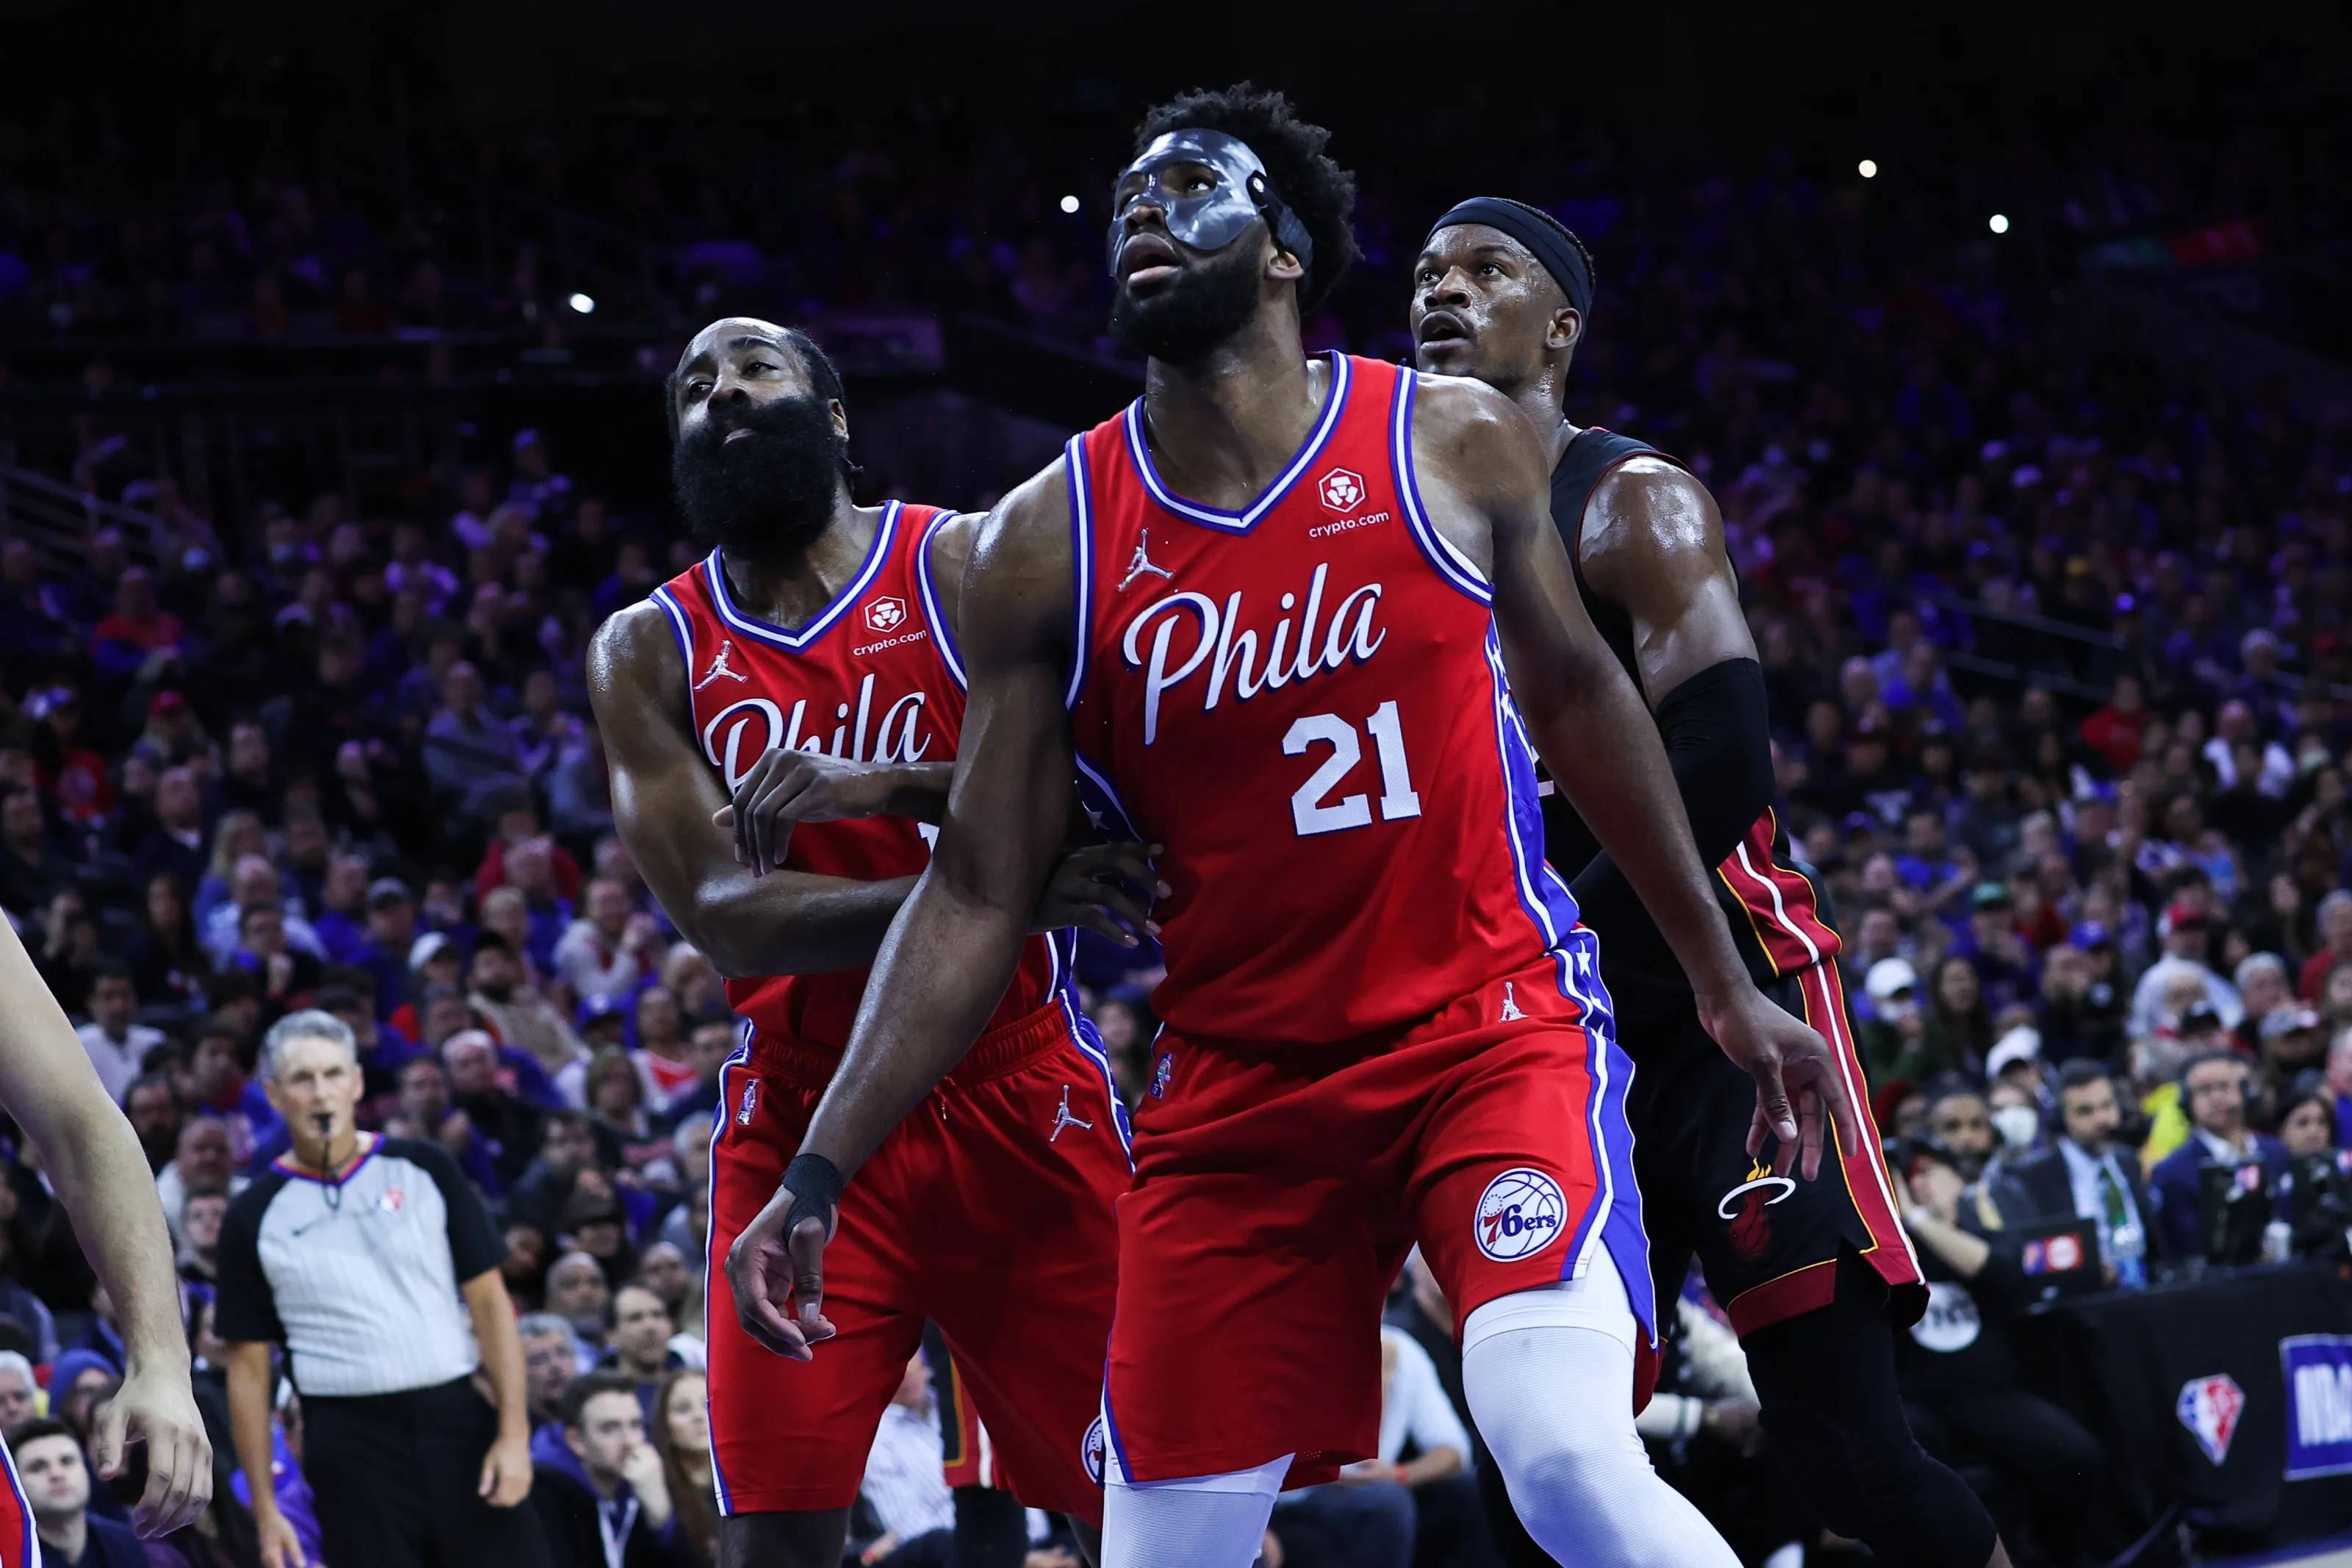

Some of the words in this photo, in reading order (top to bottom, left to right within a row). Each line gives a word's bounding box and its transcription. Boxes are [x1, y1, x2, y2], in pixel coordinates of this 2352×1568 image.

[1308, 511, 1390, 538] crypto.com
[853, 630, 927, 656] crypto.com
[1122, 562, 1387, 746] Phila
[1281, 700, 1421, 835] 21
[1483, 1204, 1556, 1246] 76ers
